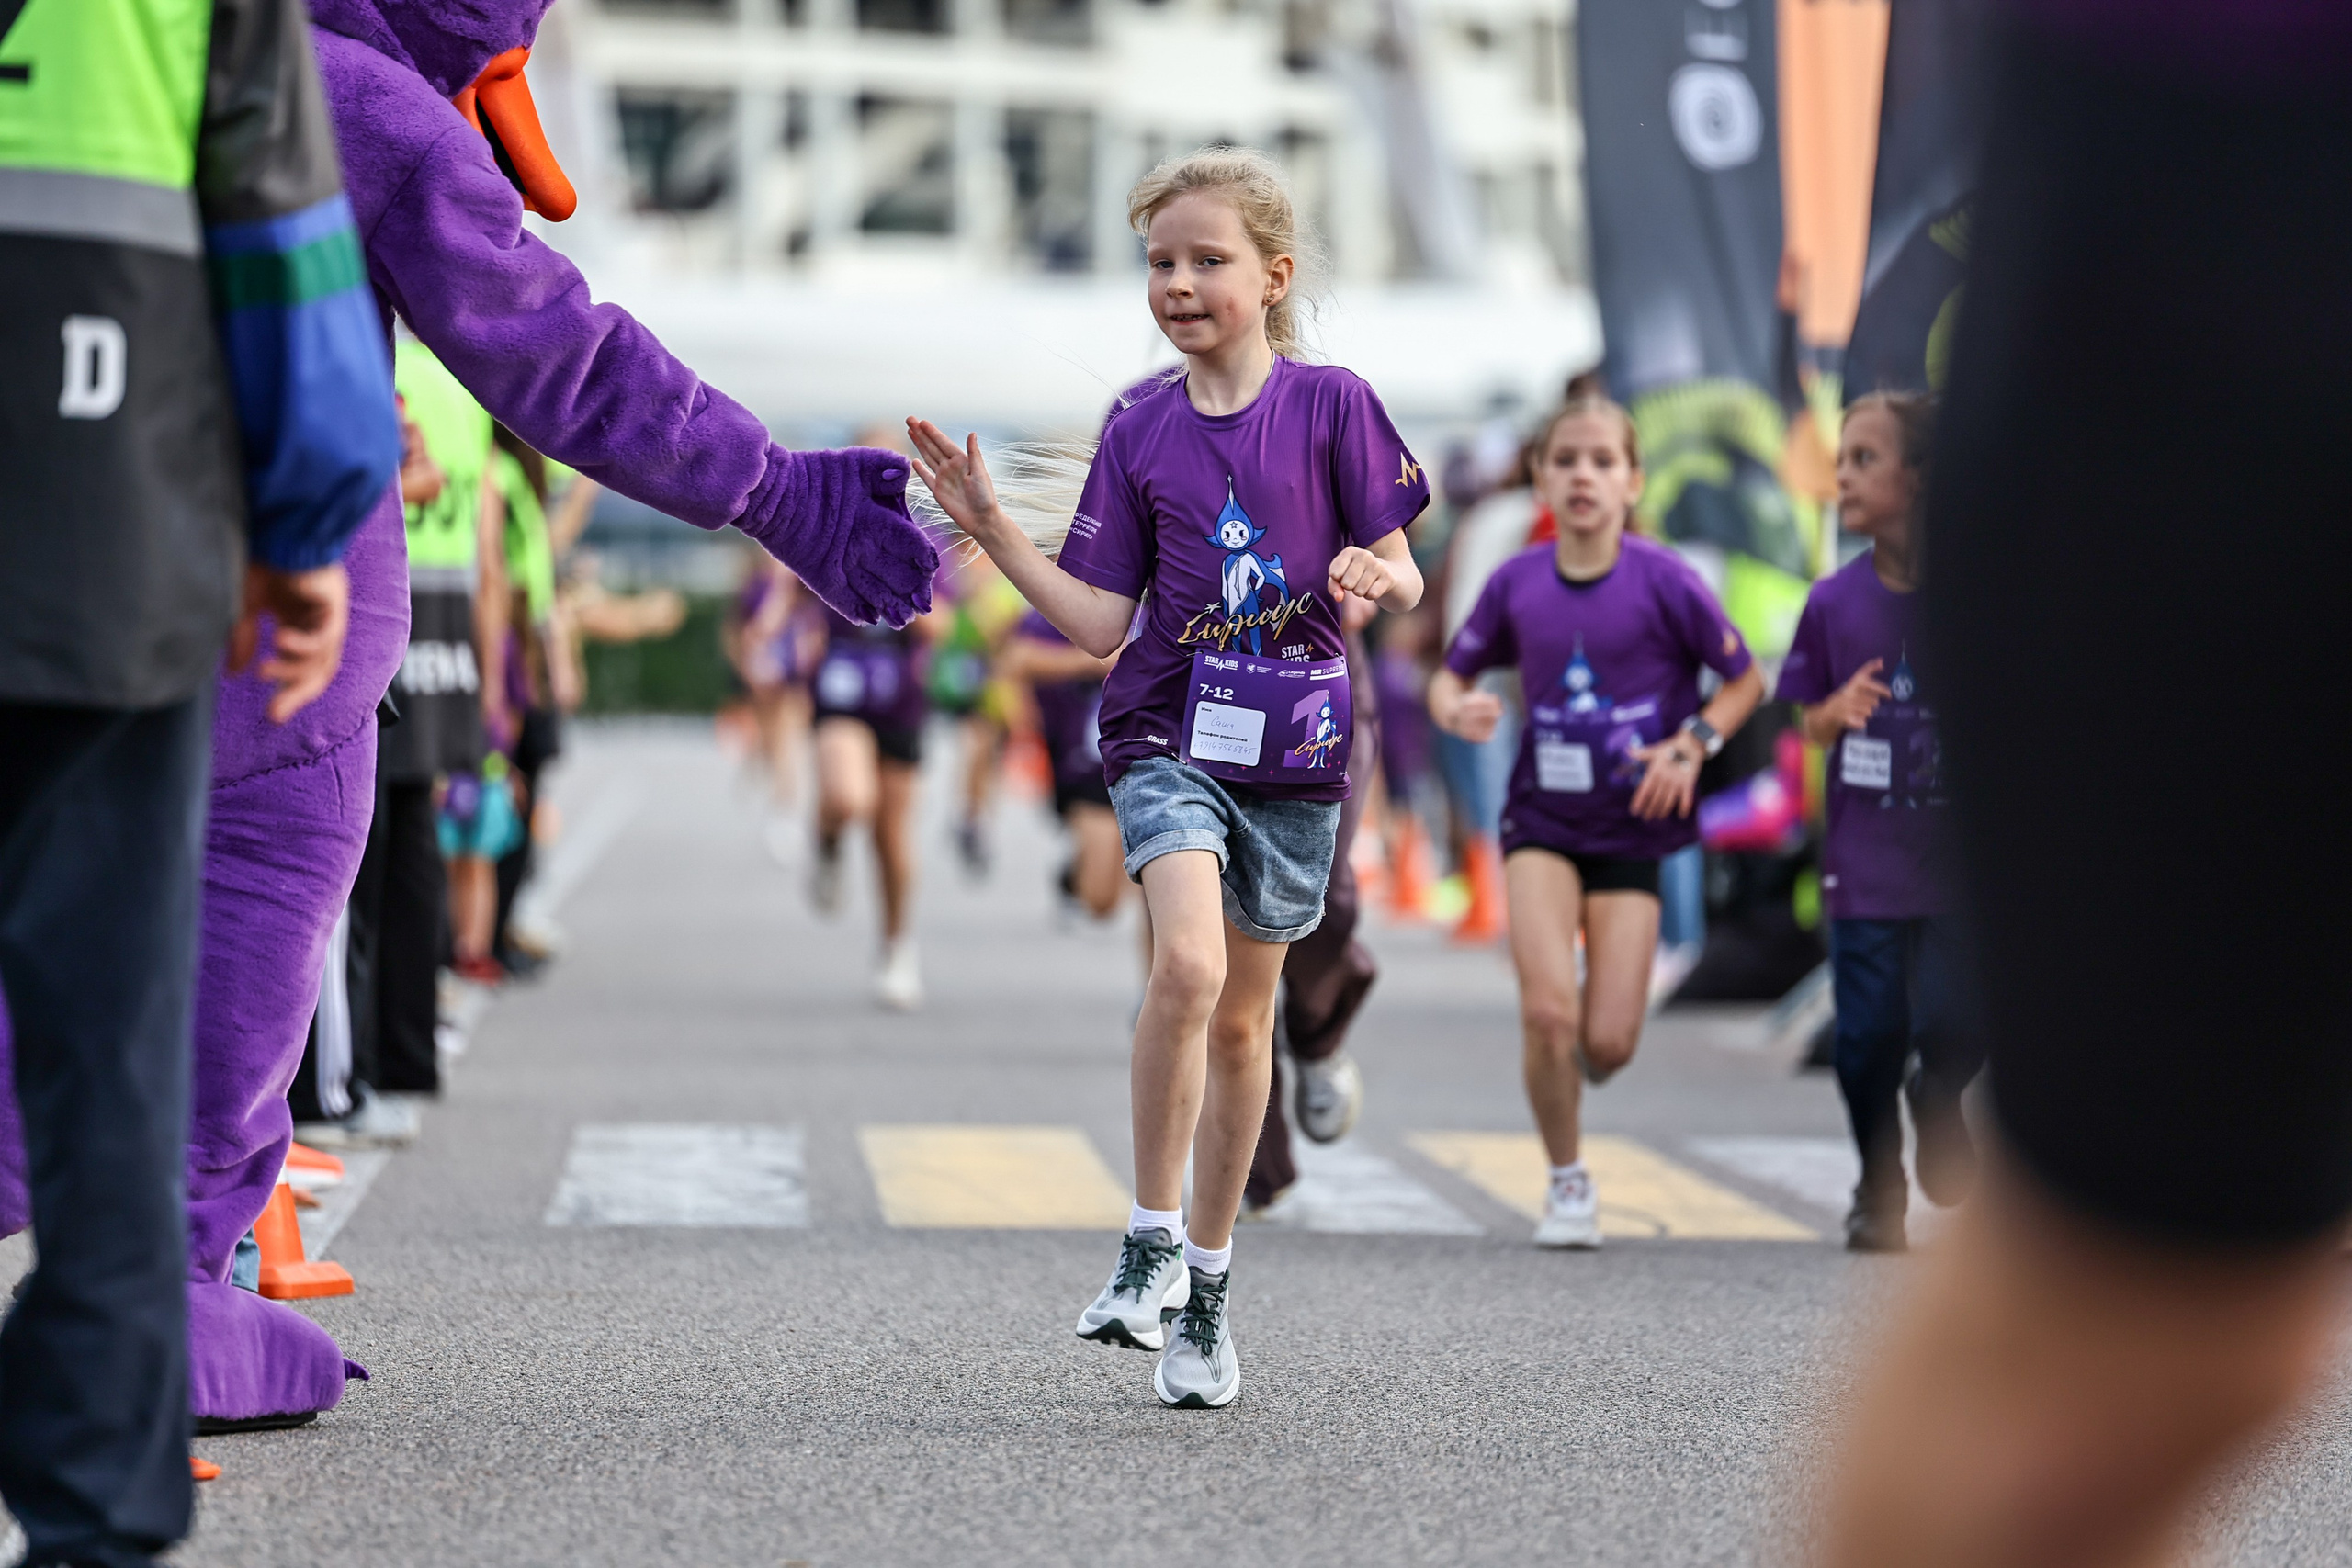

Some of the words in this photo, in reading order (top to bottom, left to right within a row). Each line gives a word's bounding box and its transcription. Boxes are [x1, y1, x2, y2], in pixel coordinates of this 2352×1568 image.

[1281, 643, 1305, 659] STAR
[1204, 655, 1219, 664] STAR
[1225, 659, 1239, 668] KIDS
[1199, 683, 1234, 700] 7-12
[1147, 734, 1169, 746] GRASS
[1197, 730, 1220, 739] Телефон
[1219, 734, 1249, 743] родителей
